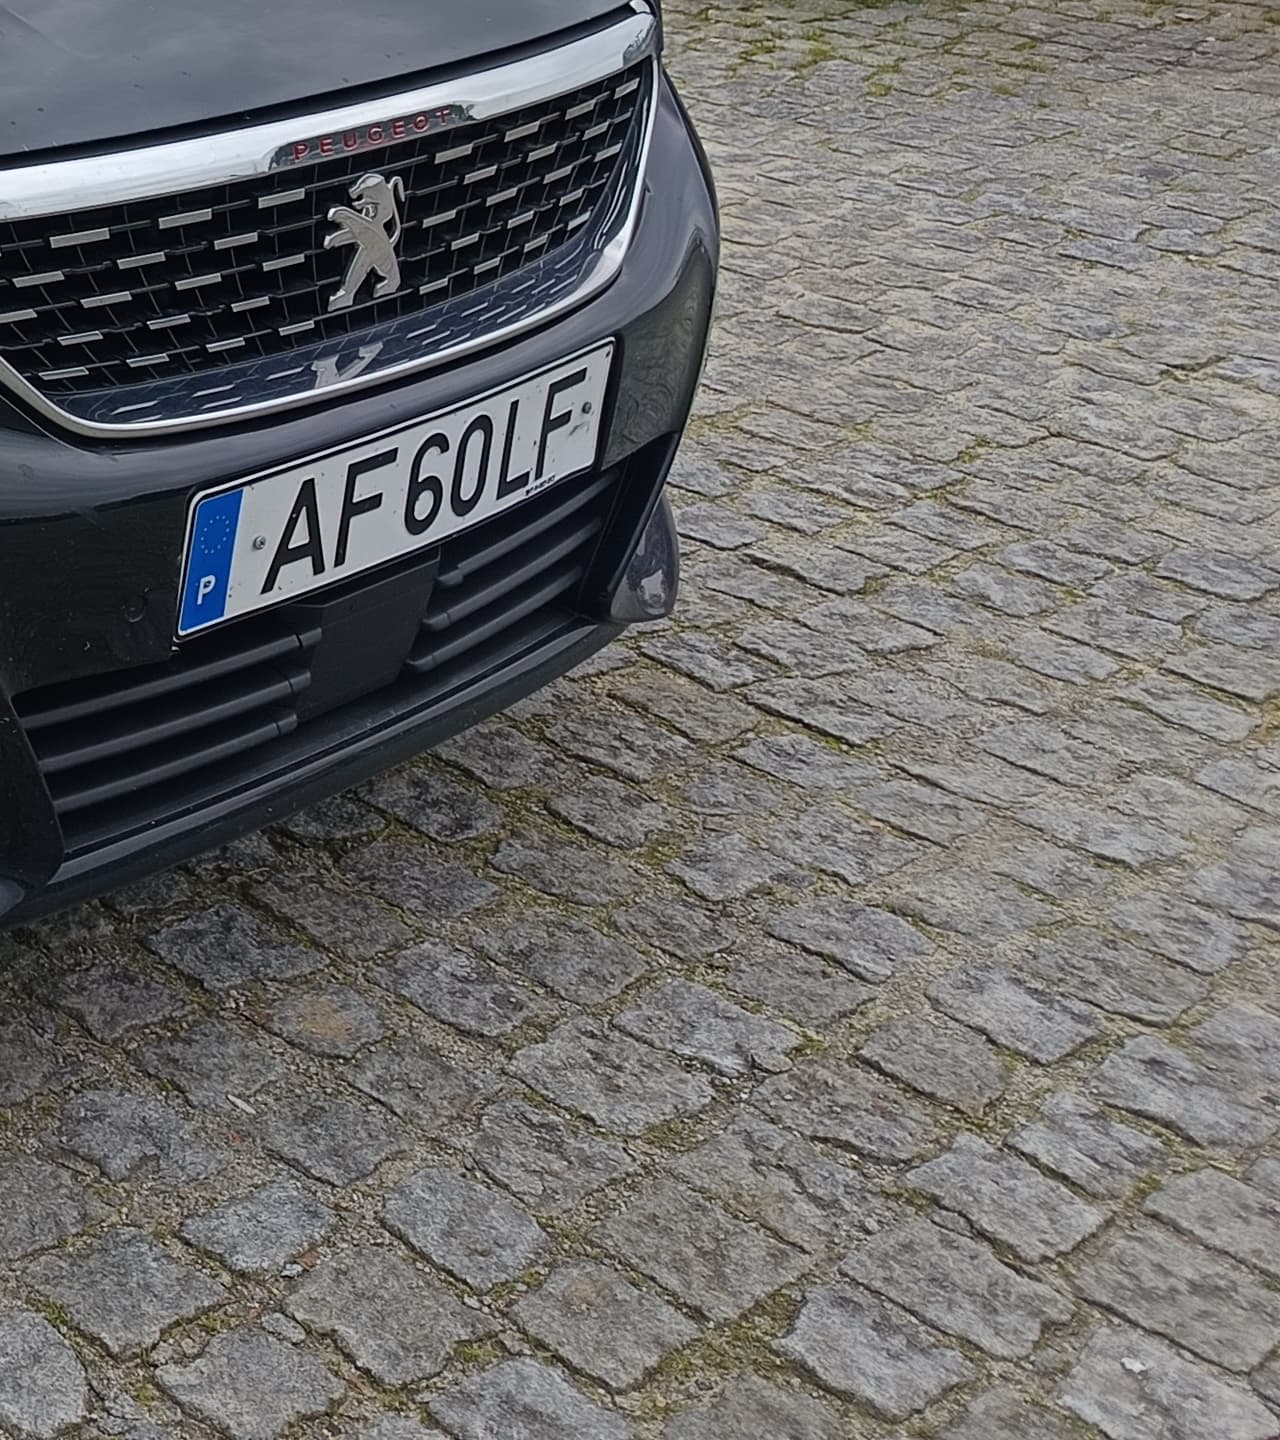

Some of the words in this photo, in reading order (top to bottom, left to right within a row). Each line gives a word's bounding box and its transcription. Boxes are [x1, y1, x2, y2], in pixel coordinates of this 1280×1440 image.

[293, 108, 450, 162] PEUGEOT
[260, 366, 588, 596] AF60LF
[195, 574, 217, 606] P
